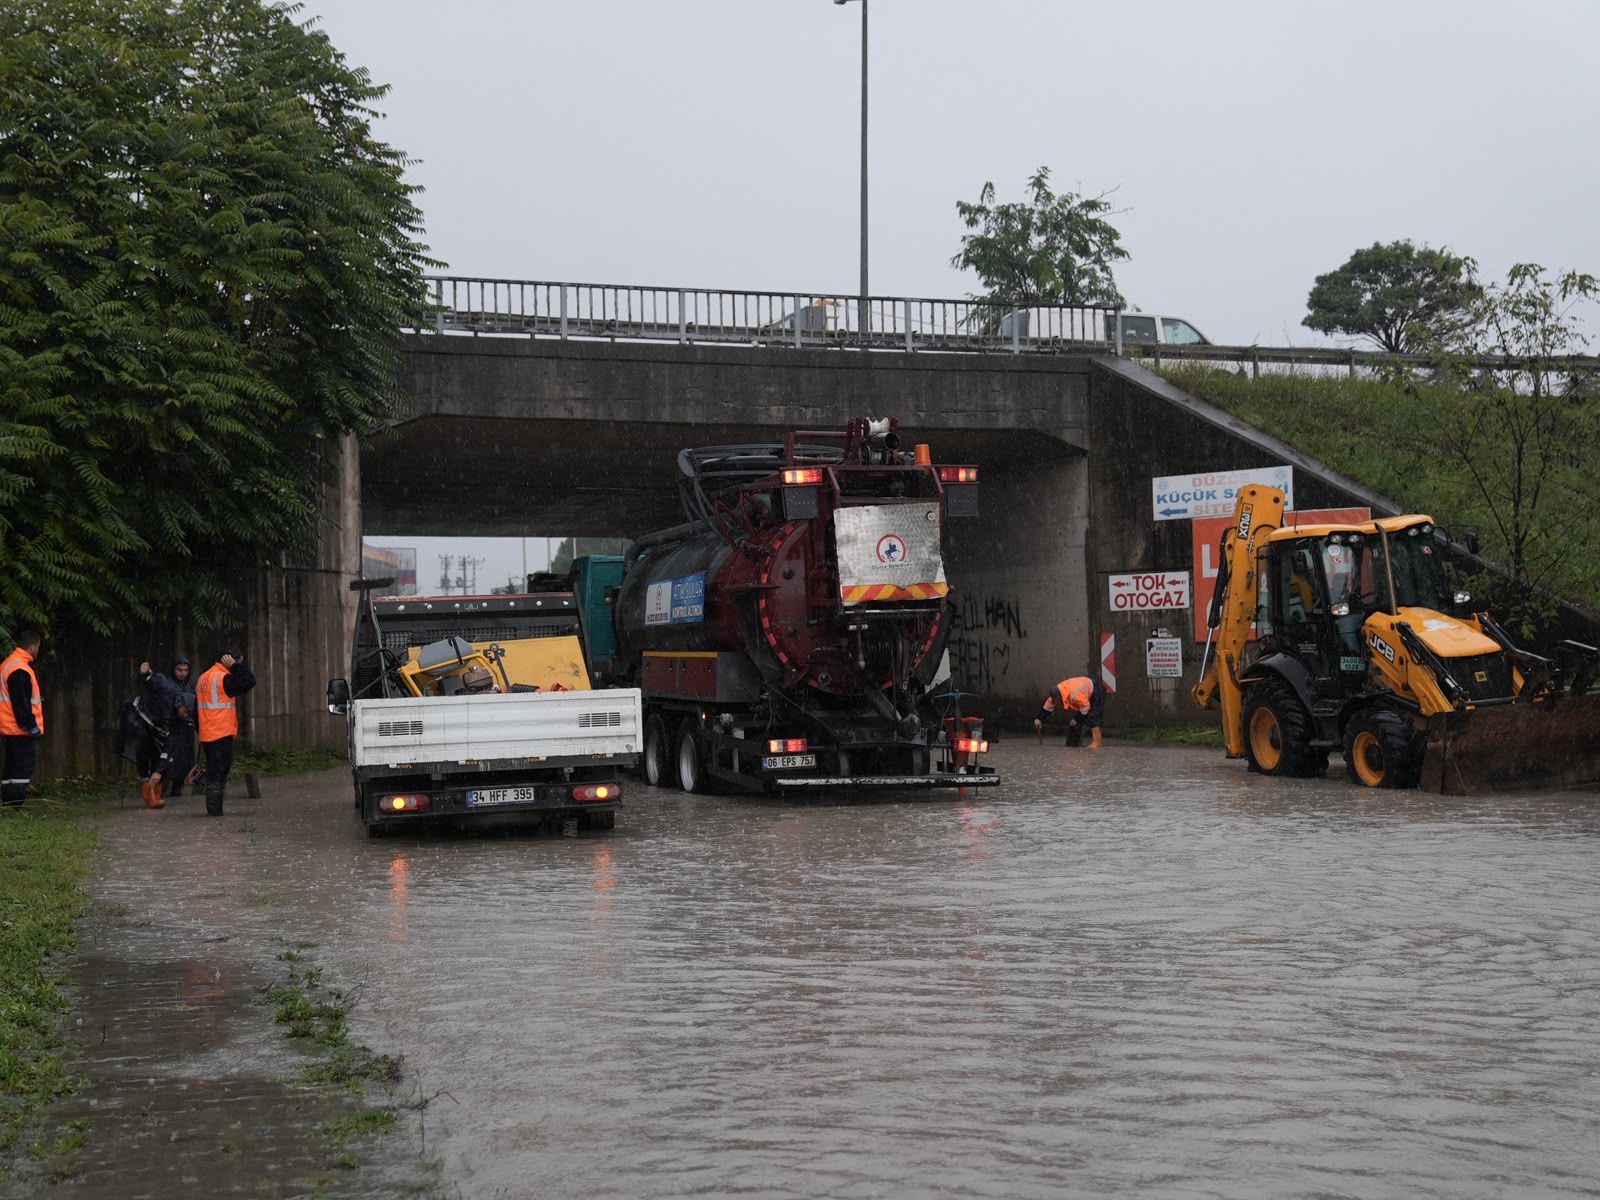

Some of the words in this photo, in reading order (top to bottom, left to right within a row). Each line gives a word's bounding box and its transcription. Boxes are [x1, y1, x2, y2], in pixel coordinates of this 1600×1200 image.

[1156, 488, 1217, 504] KÜÇÜK
[1193, 502, 1236, 516] SİTE
[1238, 513, 1250, 538] 3CX
[1132, 574, 1166, 591] TOK
[1114, 591, 1185, 609] OTOGAZ
[1370, 635, 1395, 662] JCB
[768, 758, 778, 767] 06
[781, 757, 797, 766] EPS
[800, 756, 814, 765] 757
[473, 791, 484, 802] 34
[489, 790, 507, 802] HFF
[513, 788, 532, 800] 395
